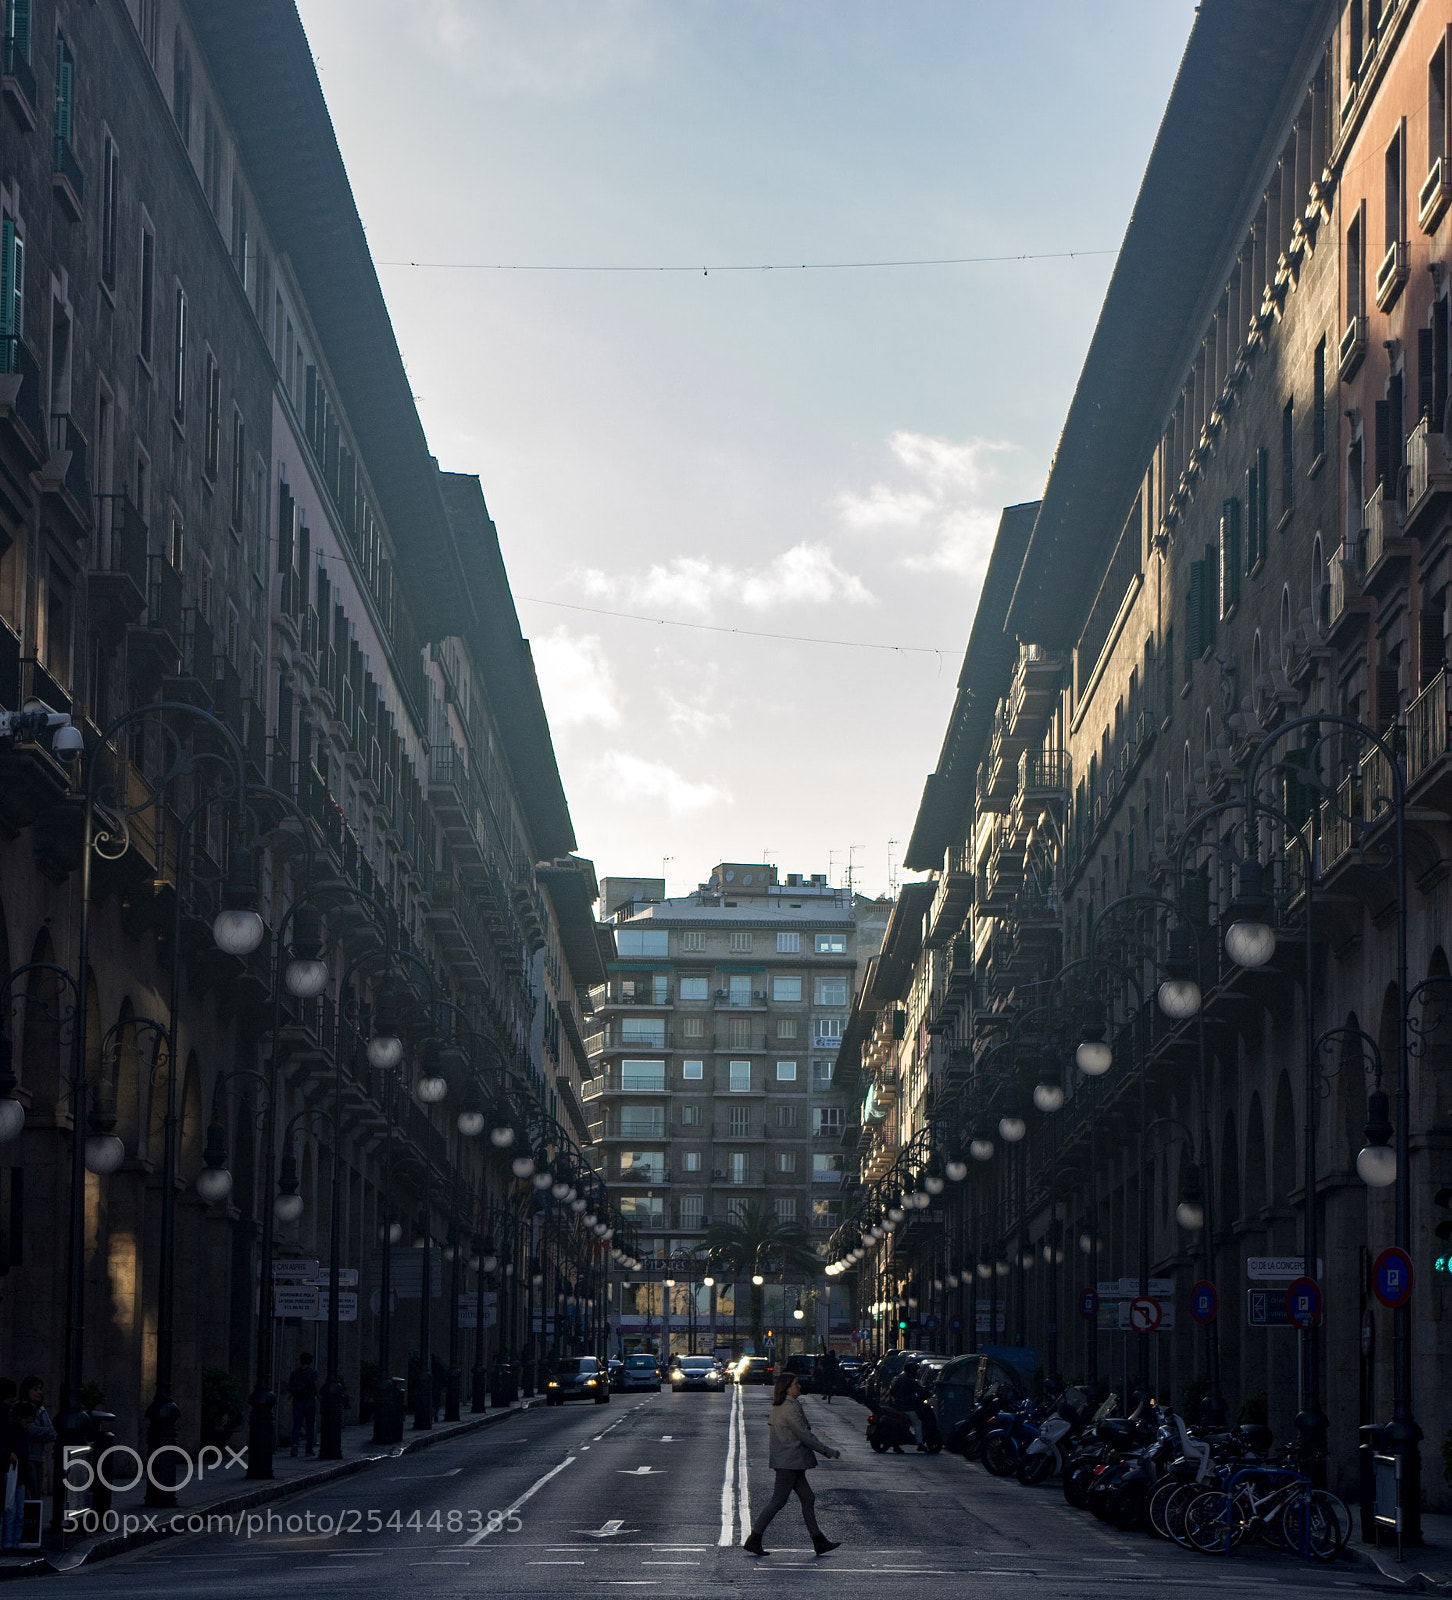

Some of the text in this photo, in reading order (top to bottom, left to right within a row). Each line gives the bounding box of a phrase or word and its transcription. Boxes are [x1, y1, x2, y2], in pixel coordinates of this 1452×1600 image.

[1268, 1261, 1275, 1270] LA
[1390, 1271, 1397, 1284] P
[1300, 1298, 1307, 1309] P
